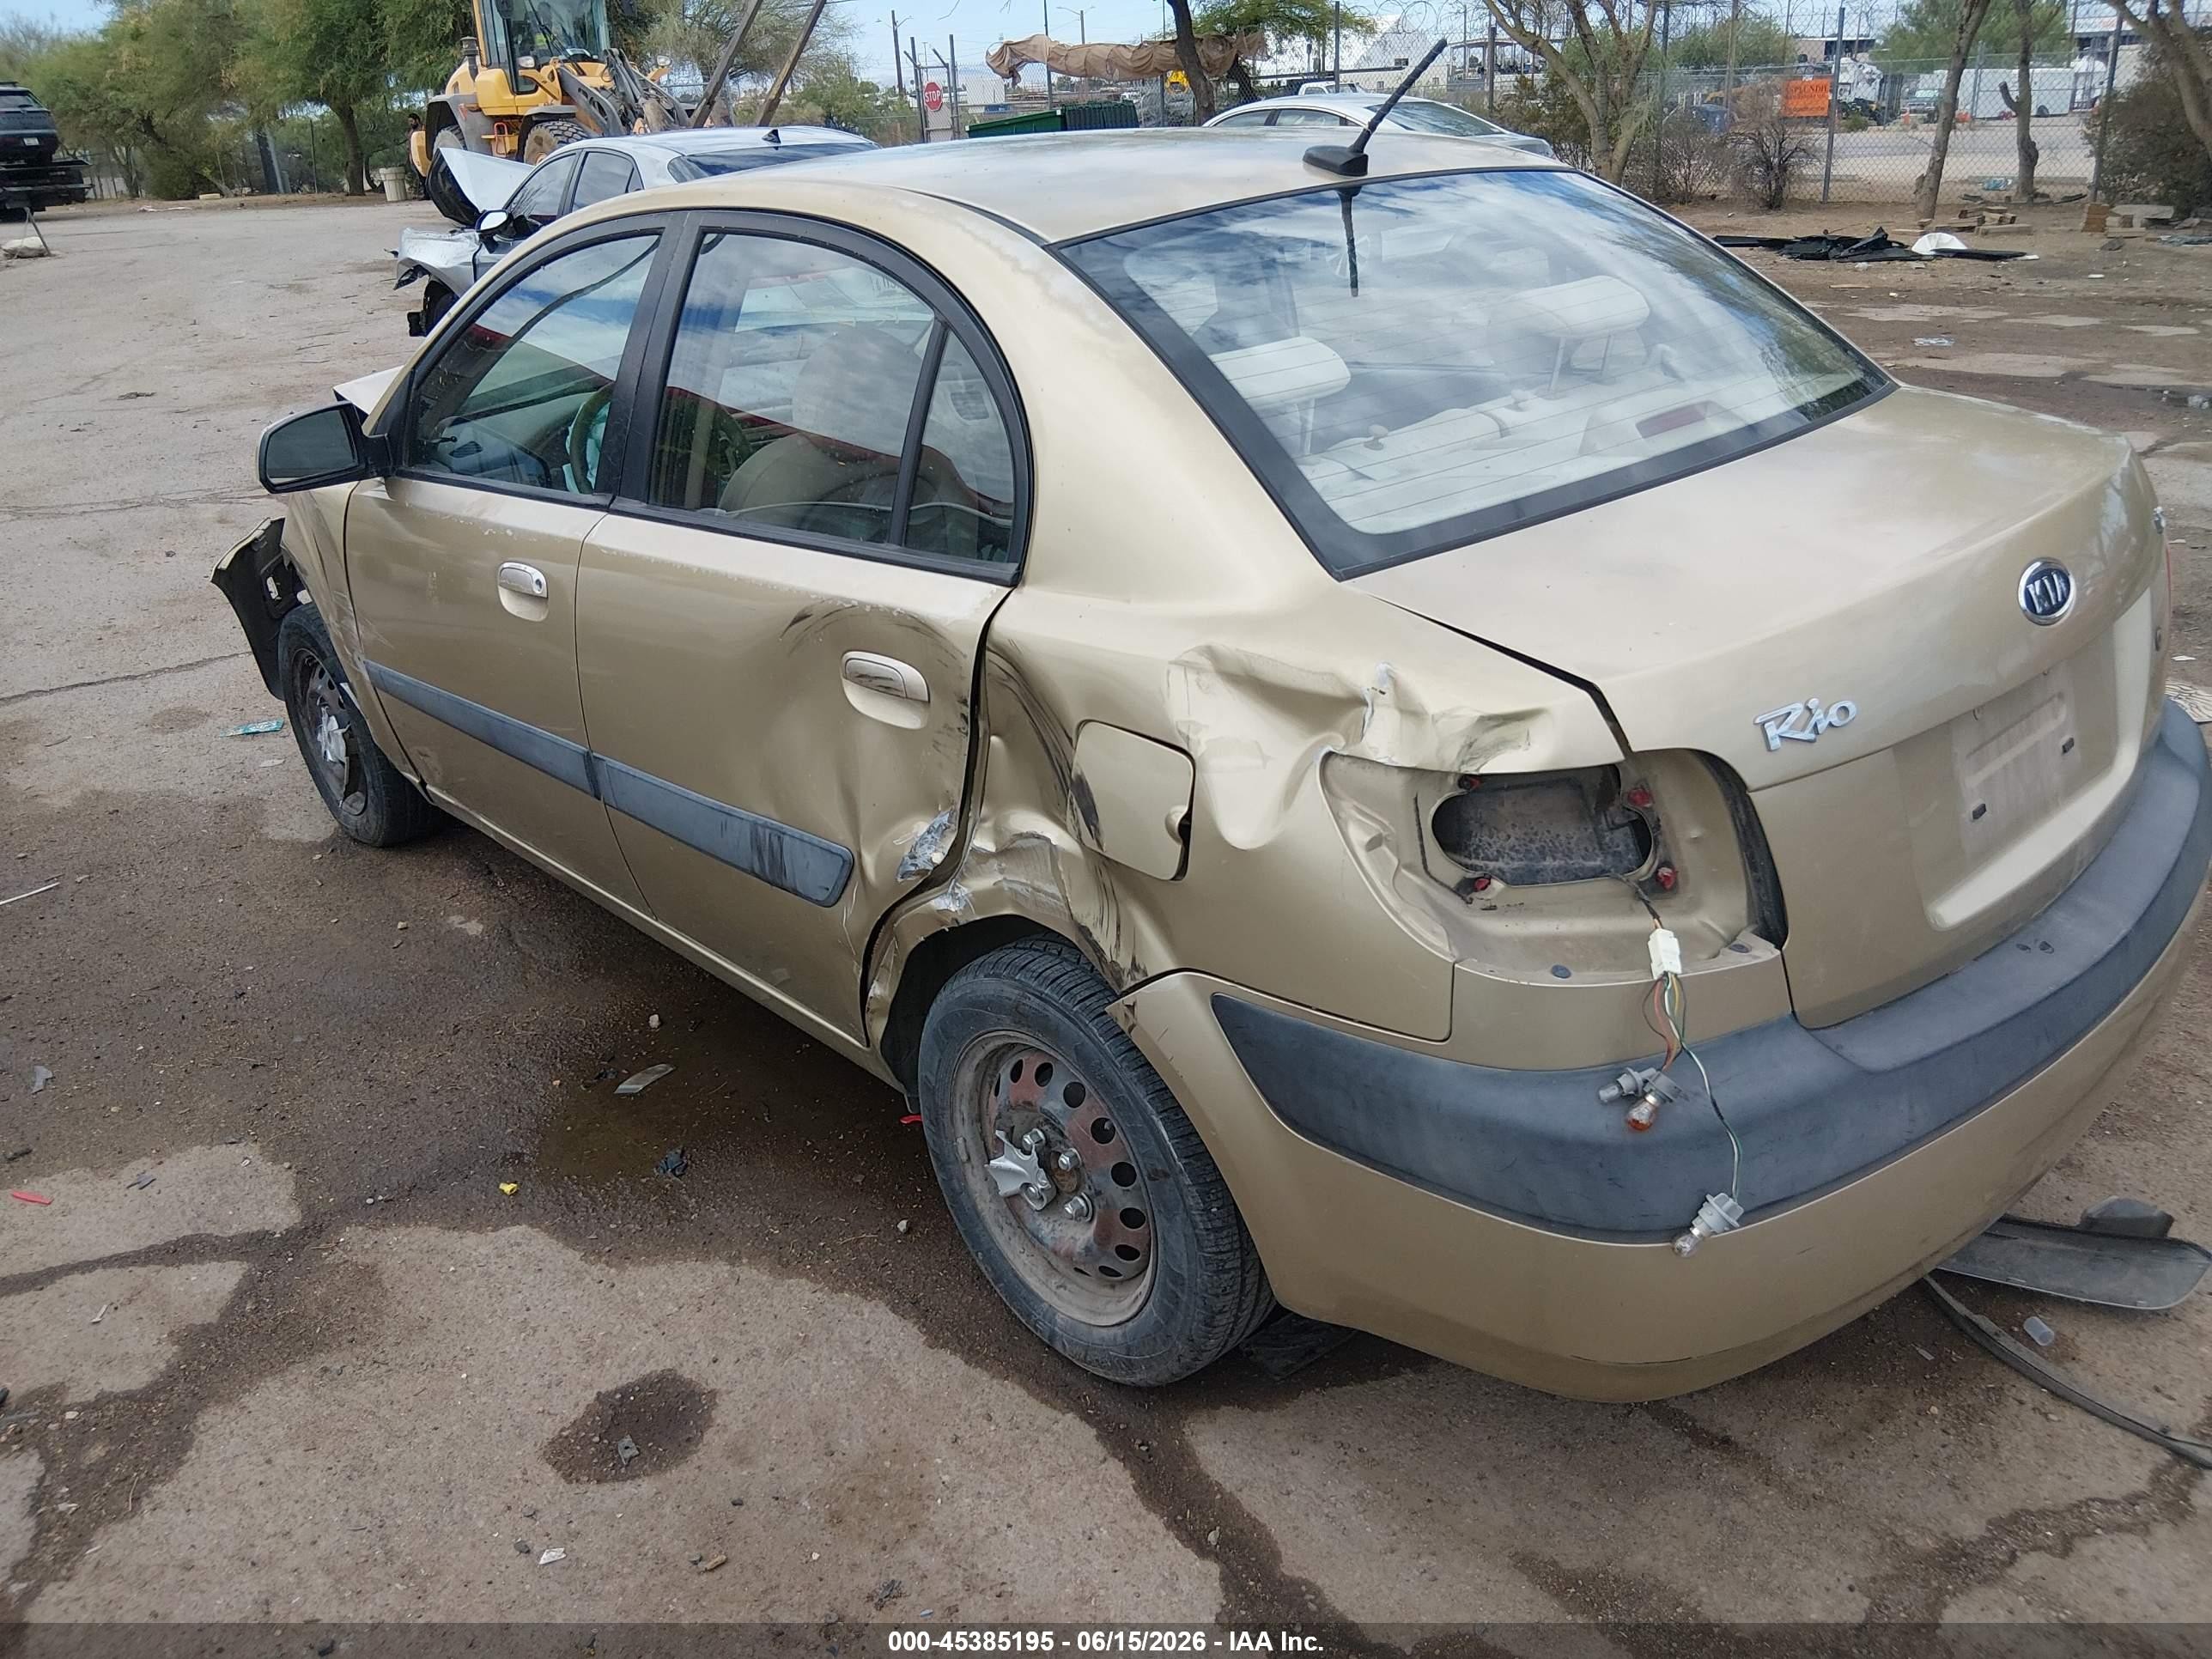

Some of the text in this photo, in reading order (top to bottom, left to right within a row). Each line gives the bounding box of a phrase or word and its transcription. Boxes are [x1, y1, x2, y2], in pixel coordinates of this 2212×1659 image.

[926, 91, 940, 102] STOP
[2026, 569, 2067, 614] KIA
[1753, 697, 1856, 752] Rio
